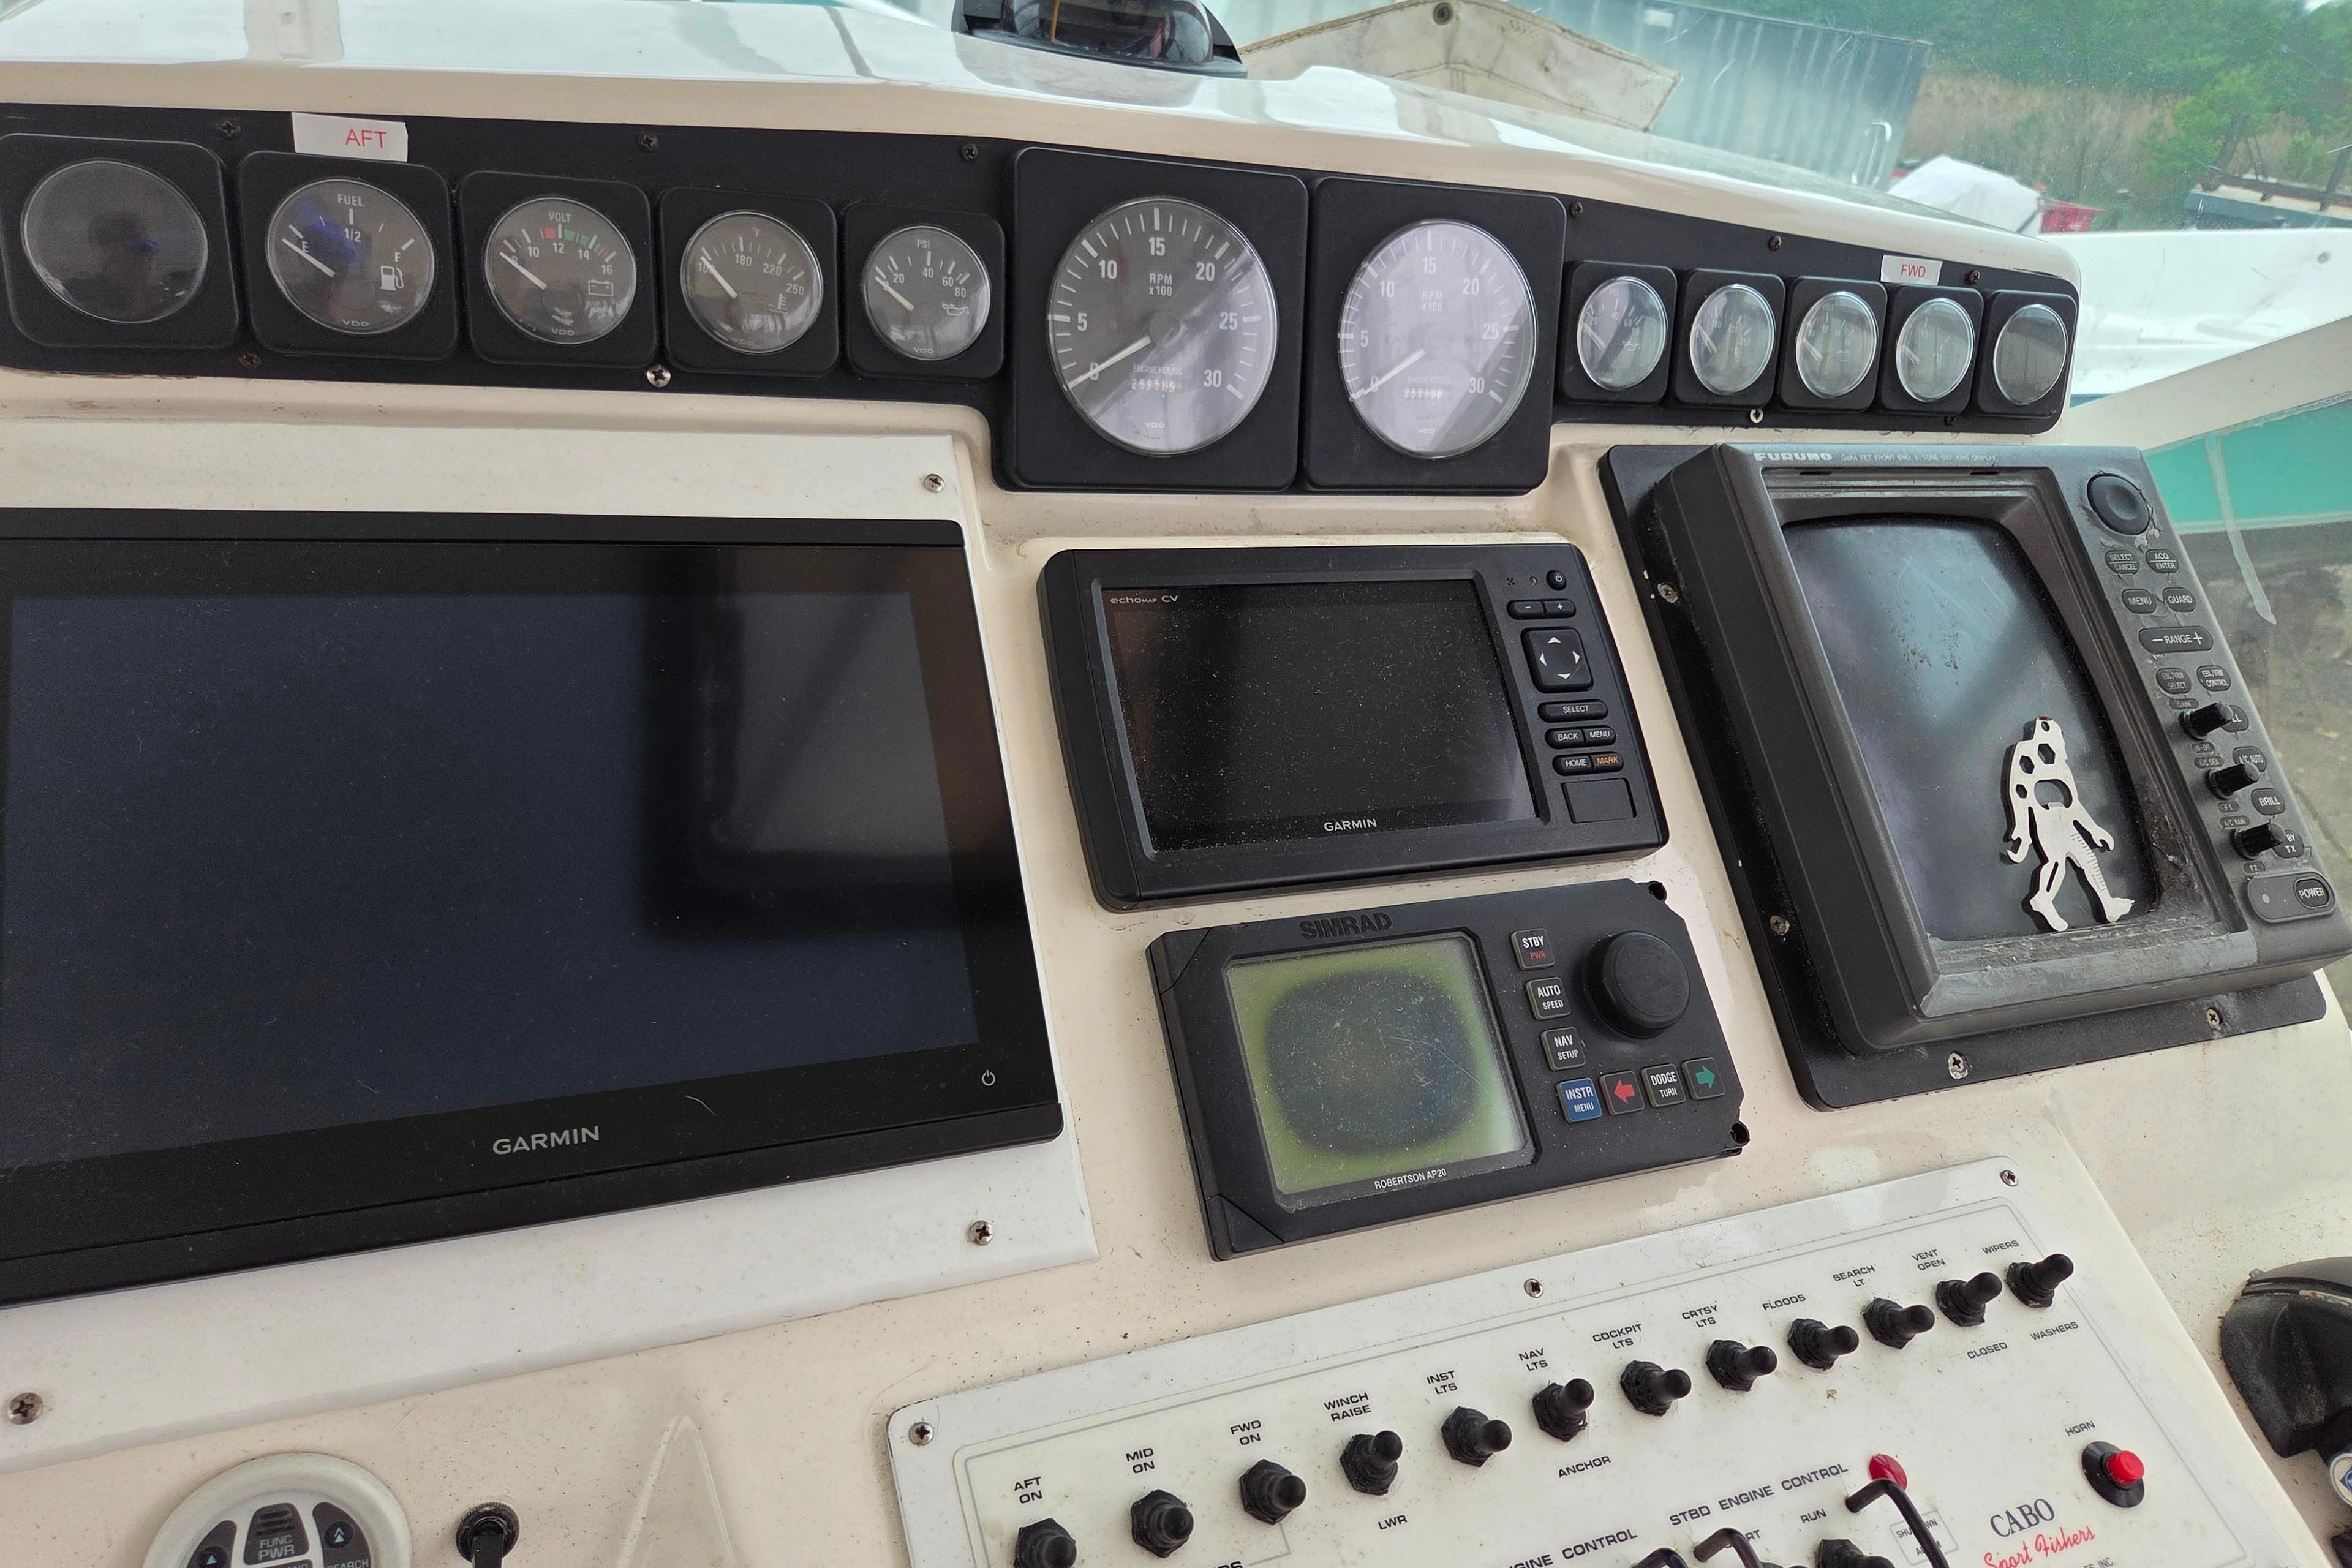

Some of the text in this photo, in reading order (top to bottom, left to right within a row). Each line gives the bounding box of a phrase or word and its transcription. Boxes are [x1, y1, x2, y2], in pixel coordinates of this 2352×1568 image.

[345, 129, 387, 148] AFT
[337, 194, 363, 206] FUEL
[549, 211, 571, 222] VOLT
[344, 228, 361, 243] 1/2
[302, 241, 309, 252] E
[552, 243, 565, 254] 12
[917, 239, 930, 249] PSI
[1149, 237, 1166, 256] 15
[394, 252, 401, 262] F
[527, 247, 539, 257] 10
[578, 250, 589, 260] 14
[735, 254, 752, 267] 180
[1422, 257, 1436, 274] 15
[601, 265, 612, 275] 16
[763, 263, 782, 276] 220
[922, 268, 933, 278] 40
[1099, 260, 1117, 279] 10
[1195, 262, 1215, 281] 20
[1901, 264, 1926, 277] FWD
[893, 274, 905, 284] 20
[943, 277, 954, 287] 60
[1149, 273, 1172, 284] RPM
[786, 283, 804, 295] 250
[956, 288, 966, 298] 80
[1381, 281, 1395, 298] 10
[1463, 278, 1479, 295] 20
[1422, 291, 1442, 300] RPM
[1077, 312, 1087, 332] 5
[1219, 312, 1238, 330] 25
[1624, 319, 1632, 328] 60
[1483, 323, 1499, 339] 25
[1361, 330, 1368, 347] 5
[1089, 363, 1099, 380] 0
[1133, 364, 1182, 376] ENGINE HOURS
[1203, 369, 1222, 387] 30
[1469, 377, 1485, 393] 30
[2128, 597, 2152, 605] MENU
[2168, 595, 2193, 604] GUARD
[2163, 634, 2193, 644] RANGE
[1562, 705, 1589, 714] SELECT
[1566, 759, 1586, 767] HOME
[2250, 755, 2264, 763] AUTO
[2258, 797, 2280, 807] BRILL
[1324, 818, 1377, 831] GARMIN
[2299, 887, 2325, 899] POWER
[1300, 912, 1392, 940] SIMRAD
[1522, 936, 1544, 948] STBY
[1529, 951, 1546, 960] PWR
[1537, 985, 1561, 998] AUTO
[1542, 1000, 1564, 1010] SPEED
[1554, 1035, 1573, 1047] NAV
[1558, 1049, 1578, 1060] SETUP
[1650, 1072, 1678, 1086] DODGE
[1565, 1087, 1594, 1101] INSTR
[1659, 1088, 1678, 1098] TURN
[1574, 1102, 1594, 1113] MENU
[492, 1126, 600, 1155] GARMIN
[1374, 1168, 1447, 1189] ROBERTSON AP20
[1982, 1240, 2019, 1255] WIPERS
[1912, 1249, 1939, 1261] VENT
[1917, 1258, 1946, 1271] OPEN
[1832, 1265, 1875, 1282] SEARCH
[1853, 1278, 1865, 1287] LT
[1762, 1294, 1806, 1311] FLOODS
[1682, 1305, 1718, 1320] CRTSY
[1695, 1317, 1716, 1328] LTS
[1593, 1323, 1643, 1343] COCKPIT
[2030, 1321, 2079, 1341] WASHERS
[1613, 1338, 1634, 1349] LTS
[1518, 1348, 1545, 1362] NAV
[1967, 1342, 2008, 1359] CLOSED
[1526, 1359, 1548, 1372] LTS
[1426, 1370, 1456, 1385] INST
[1434, 1382, 1458, 1395] LTS
[1324, 1392, 1369, 1411] WINCH
[1330, 1404, 1371, 1422] RAISE
[1230, 1419, 1262, 1435] FWD
[2065, 1420, 2095, 1436] HORN
[1239, 1433, 1261, 1446] ON
[1126, 1447, 1154, 1462] MID
[1133, 1461, 1155, 1474] ON
[1558, 1455, 1611, 1478] ANCHOR
[1014, 1476, 1042, 1491] AFT
[1019, 1490, 1042, 1504] ON
[1670, 1463, 1848, 1526] STBD ENGINE CONTROL
[1378, 1515, 1408, 1530] LWR
[1800, 1509, 1826, 1524] RUN
[1990, 1498, 2055, 1537] CABO
[1896, 1518, 1939, 1538] SHUWN
[260, 1535, 293, 1548] FUNC
[1562, 1529, 1637, 1559] CONTROL
[1985, 1526, 2095, 1568] Sport Fishers
[258, 1545, 295, 1561] PWR
